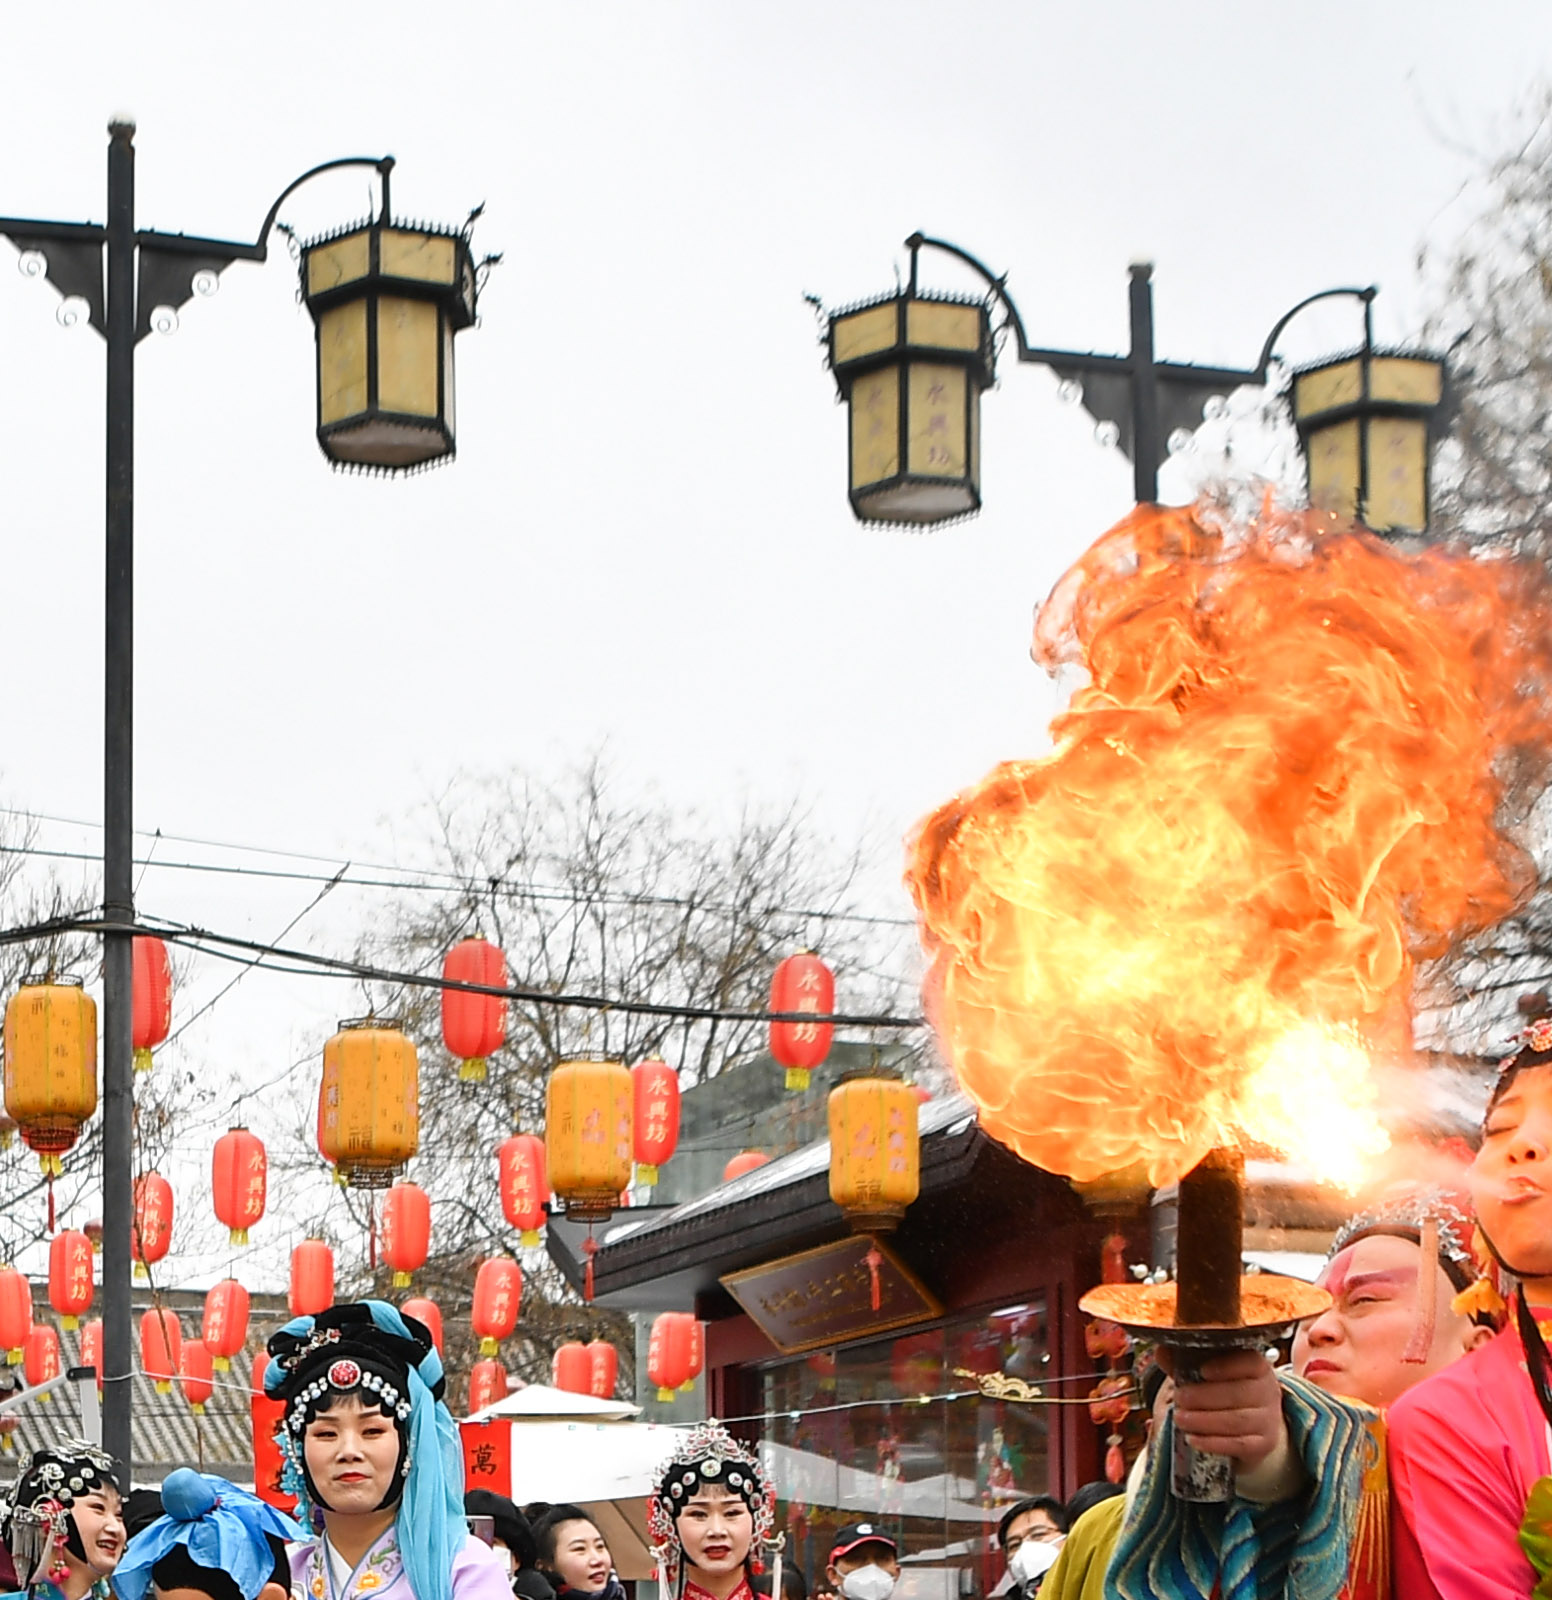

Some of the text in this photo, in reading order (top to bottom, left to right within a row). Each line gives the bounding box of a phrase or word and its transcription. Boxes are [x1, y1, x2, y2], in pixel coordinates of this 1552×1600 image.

[645, 1076, 670, 1143] 永興坊
[245, 1150, 265, 1216] 永興坊
[509, 1151, 530, 1215] 永興坊
[70, 1243, 90, 1301] 永興坊
[490, 1271, 511, 1326] 永興坊
[81, 1329, 94, 1363] 永興
[207, 1293, 225, 1343] 永興坊
[471, 1445, 498, 1476] 萬
